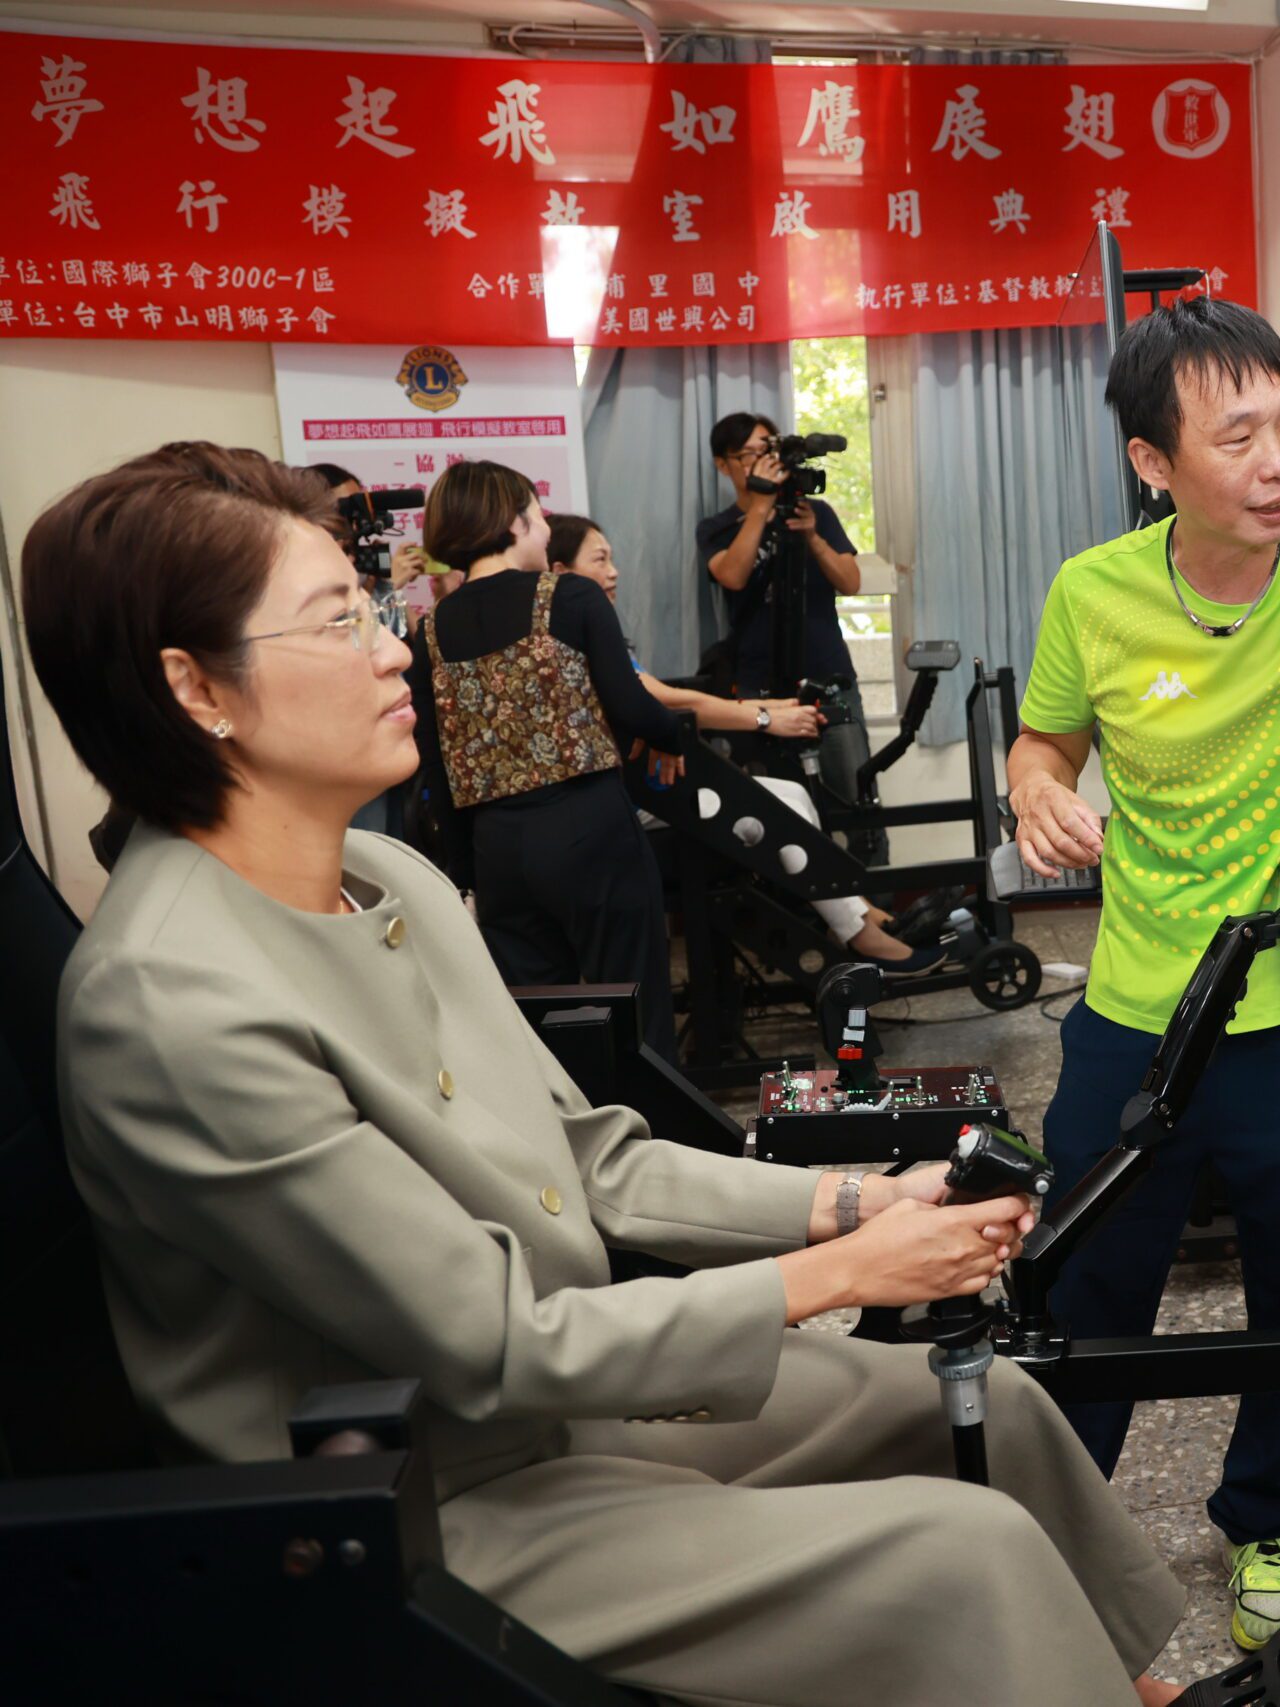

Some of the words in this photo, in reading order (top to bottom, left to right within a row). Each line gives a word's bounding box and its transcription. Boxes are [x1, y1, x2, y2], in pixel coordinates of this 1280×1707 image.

[31, 54, 1124, 163] 夢想起飛如鷹展翅
